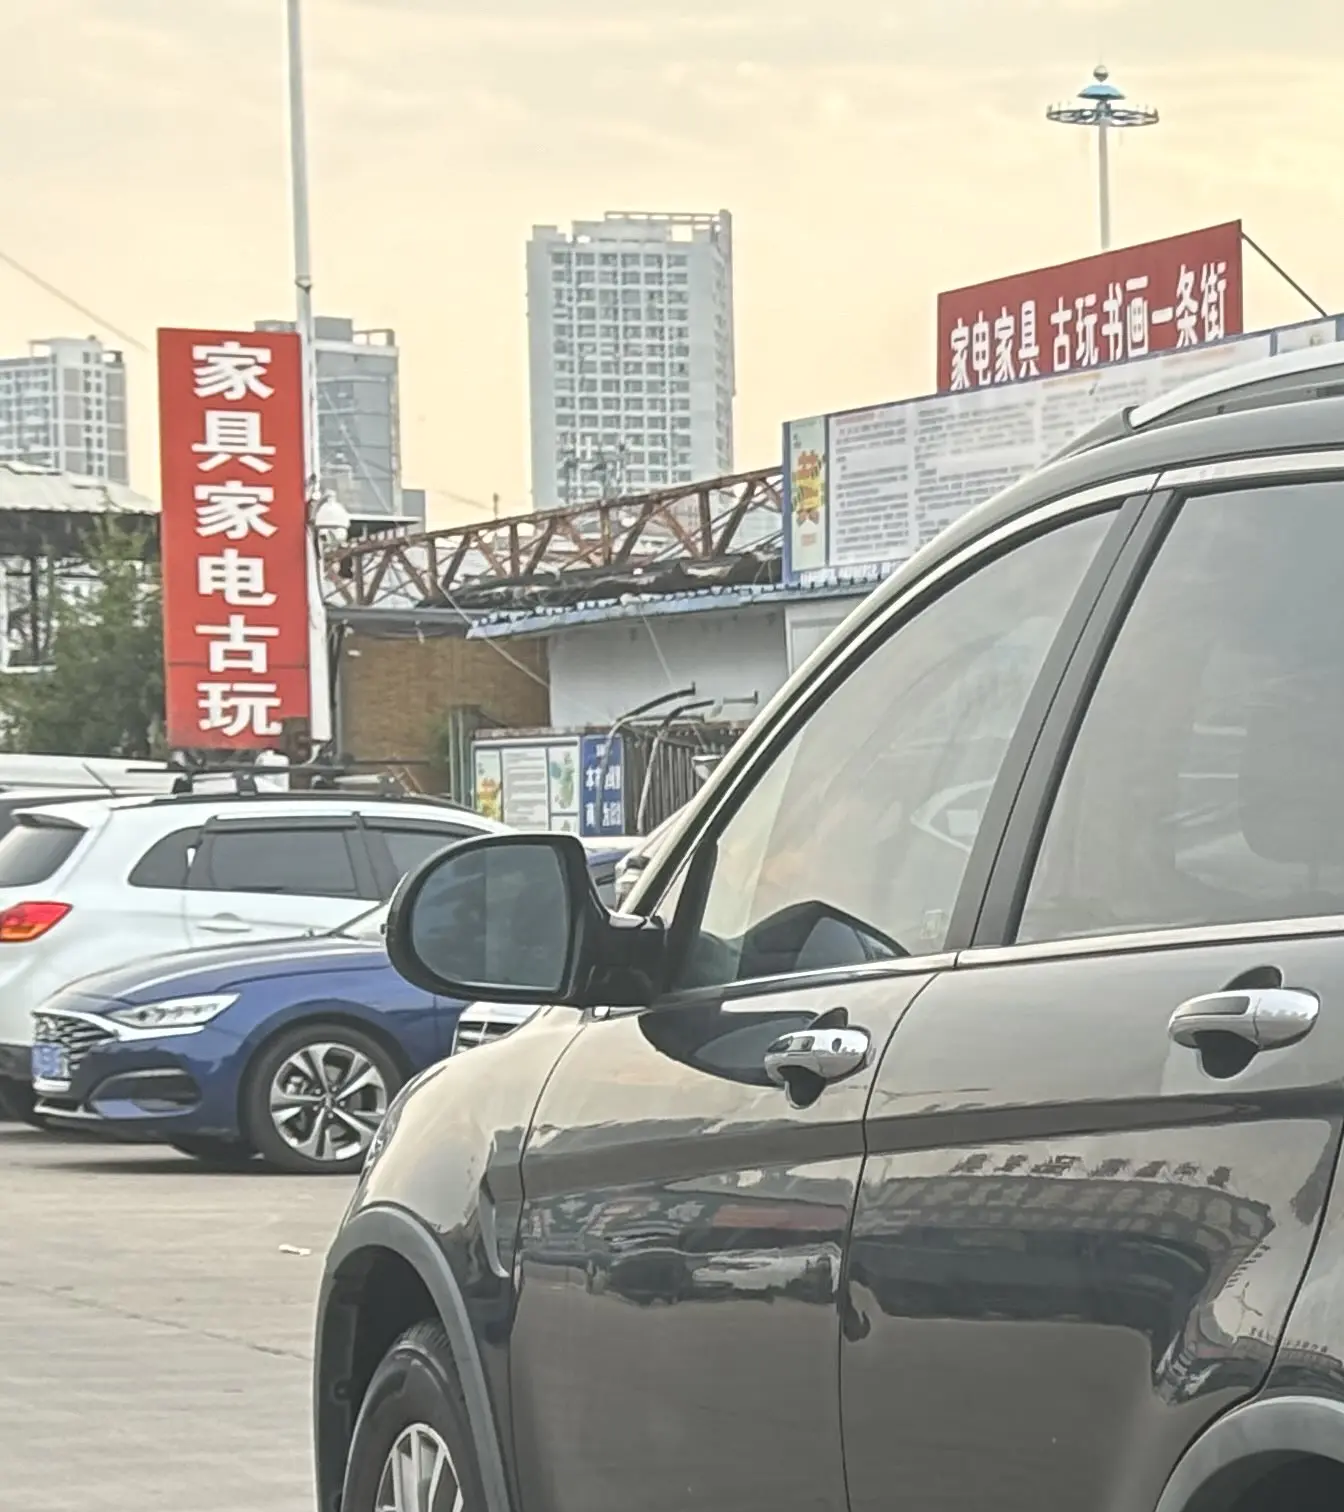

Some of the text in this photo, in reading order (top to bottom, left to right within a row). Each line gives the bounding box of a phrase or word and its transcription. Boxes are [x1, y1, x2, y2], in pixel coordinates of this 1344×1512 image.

[949, 261, 1230, 392] 家电家具 古玩书画一条街
[191, 341, 282, 738] 家具家电古玩
